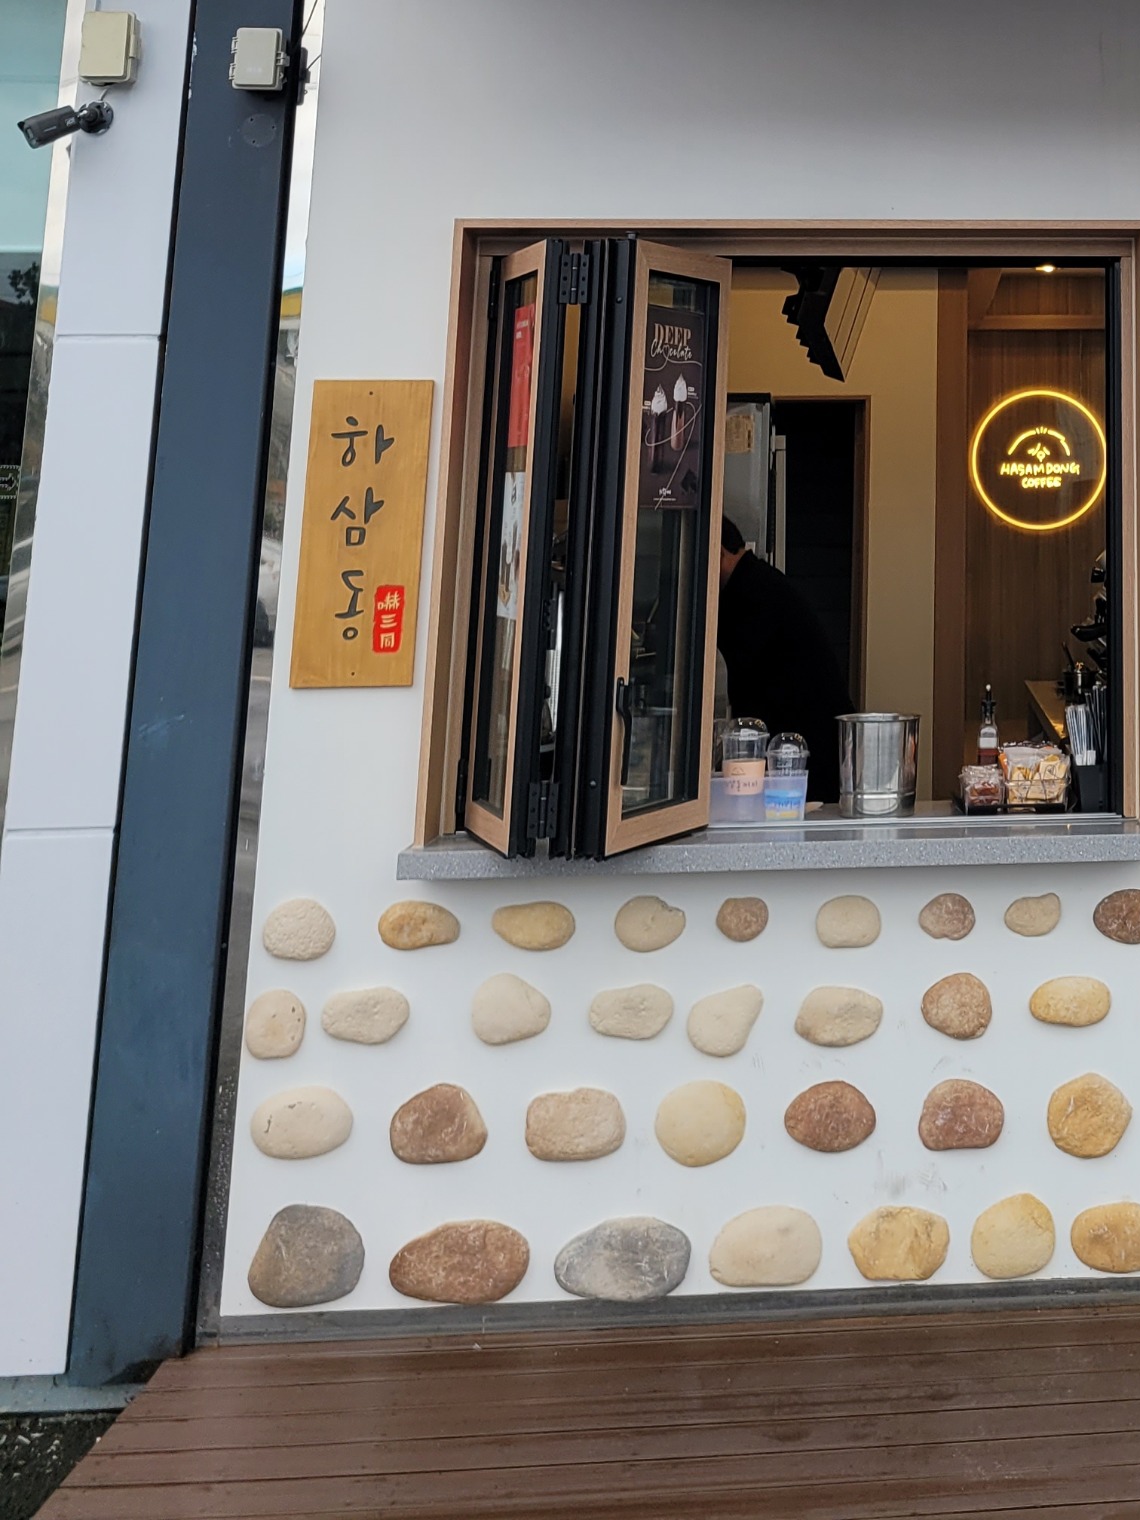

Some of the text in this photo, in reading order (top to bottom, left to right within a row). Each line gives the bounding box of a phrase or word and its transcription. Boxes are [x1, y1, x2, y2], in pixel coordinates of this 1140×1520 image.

[654, 323, 692, 346] DEEP
[1000, 462, 1080, 476] HASAMDONG
[1021, 477, 1062, 488] COFFEE
[330, 416, 395, 641] 하삼동
